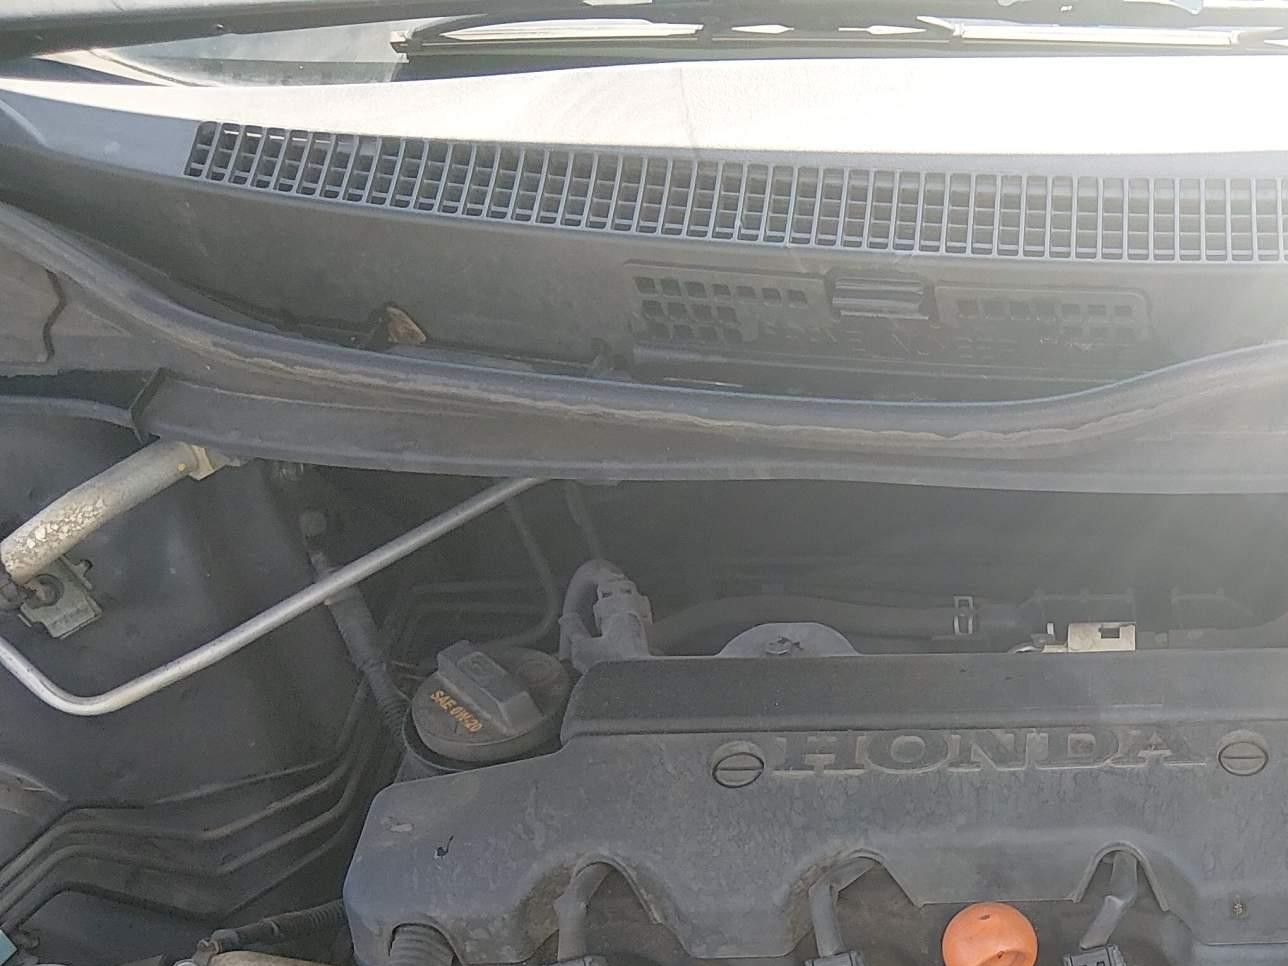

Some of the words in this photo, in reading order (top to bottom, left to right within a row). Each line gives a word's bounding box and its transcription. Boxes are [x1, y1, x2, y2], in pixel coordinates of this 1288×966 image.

[430, 689, 456, 711] SAE
[450, 704, 482, 733] 0W-20
[772, 728, 1206, 777] HONDA
